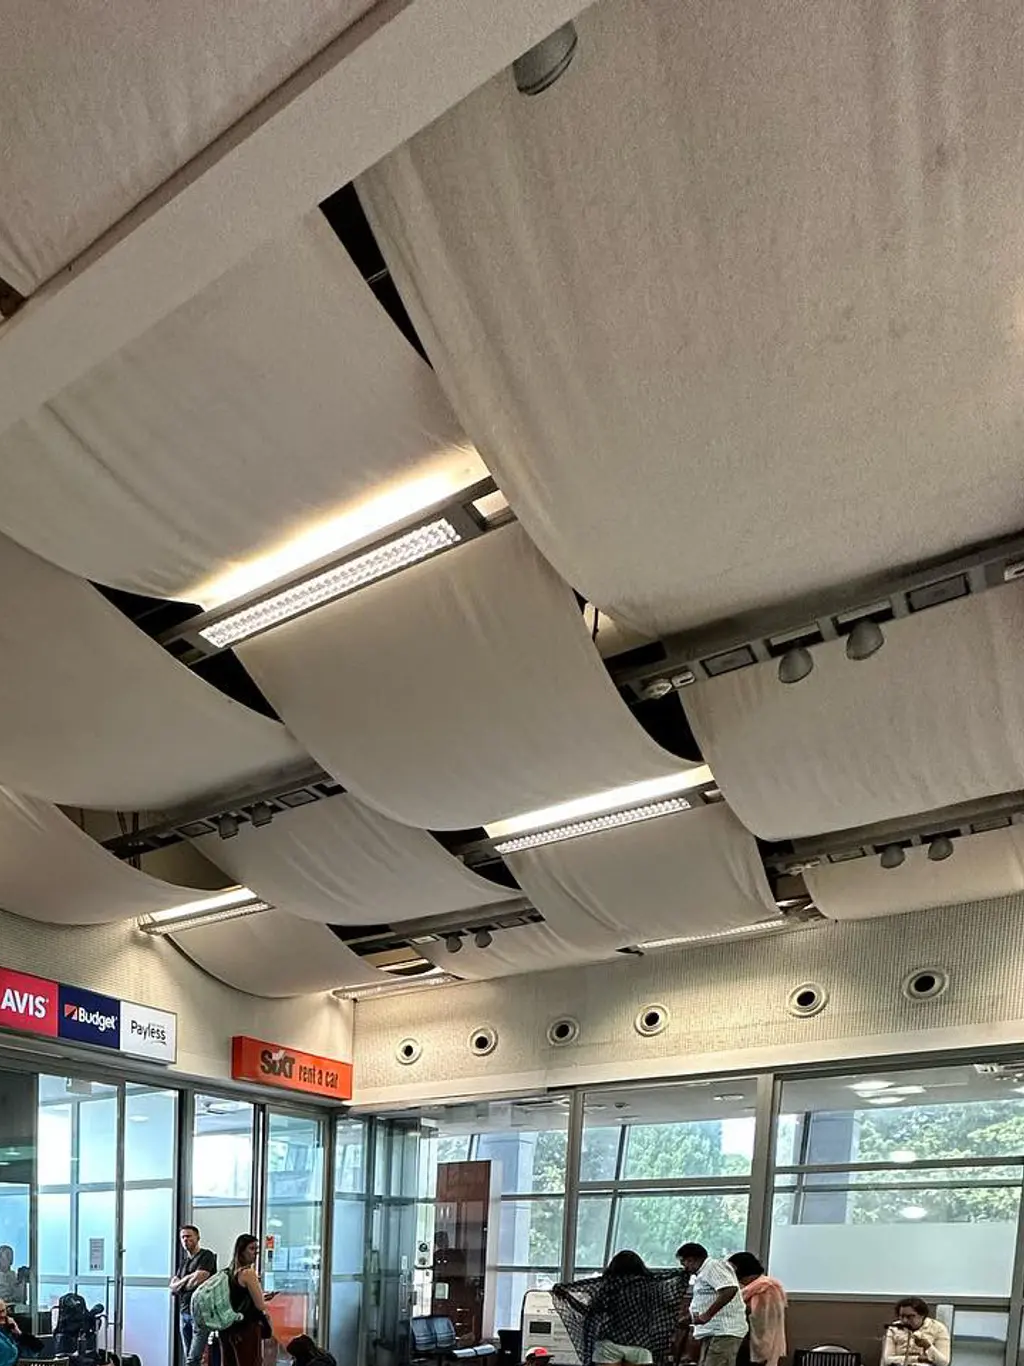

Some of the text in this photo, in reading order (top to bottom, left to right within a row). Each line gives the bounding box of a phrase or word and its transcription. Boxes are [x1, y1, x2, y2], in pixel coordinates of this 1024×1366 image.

[0, 988, 47, 1019] AVIS
[78, 1006, 117, 1032] Budget
[130, 1019, 167, 1041] Payless
[298, 1064, 317, 1085] rent
[317, 1068, 324, 1086] a
[324, 1070, 339, 1089] car
